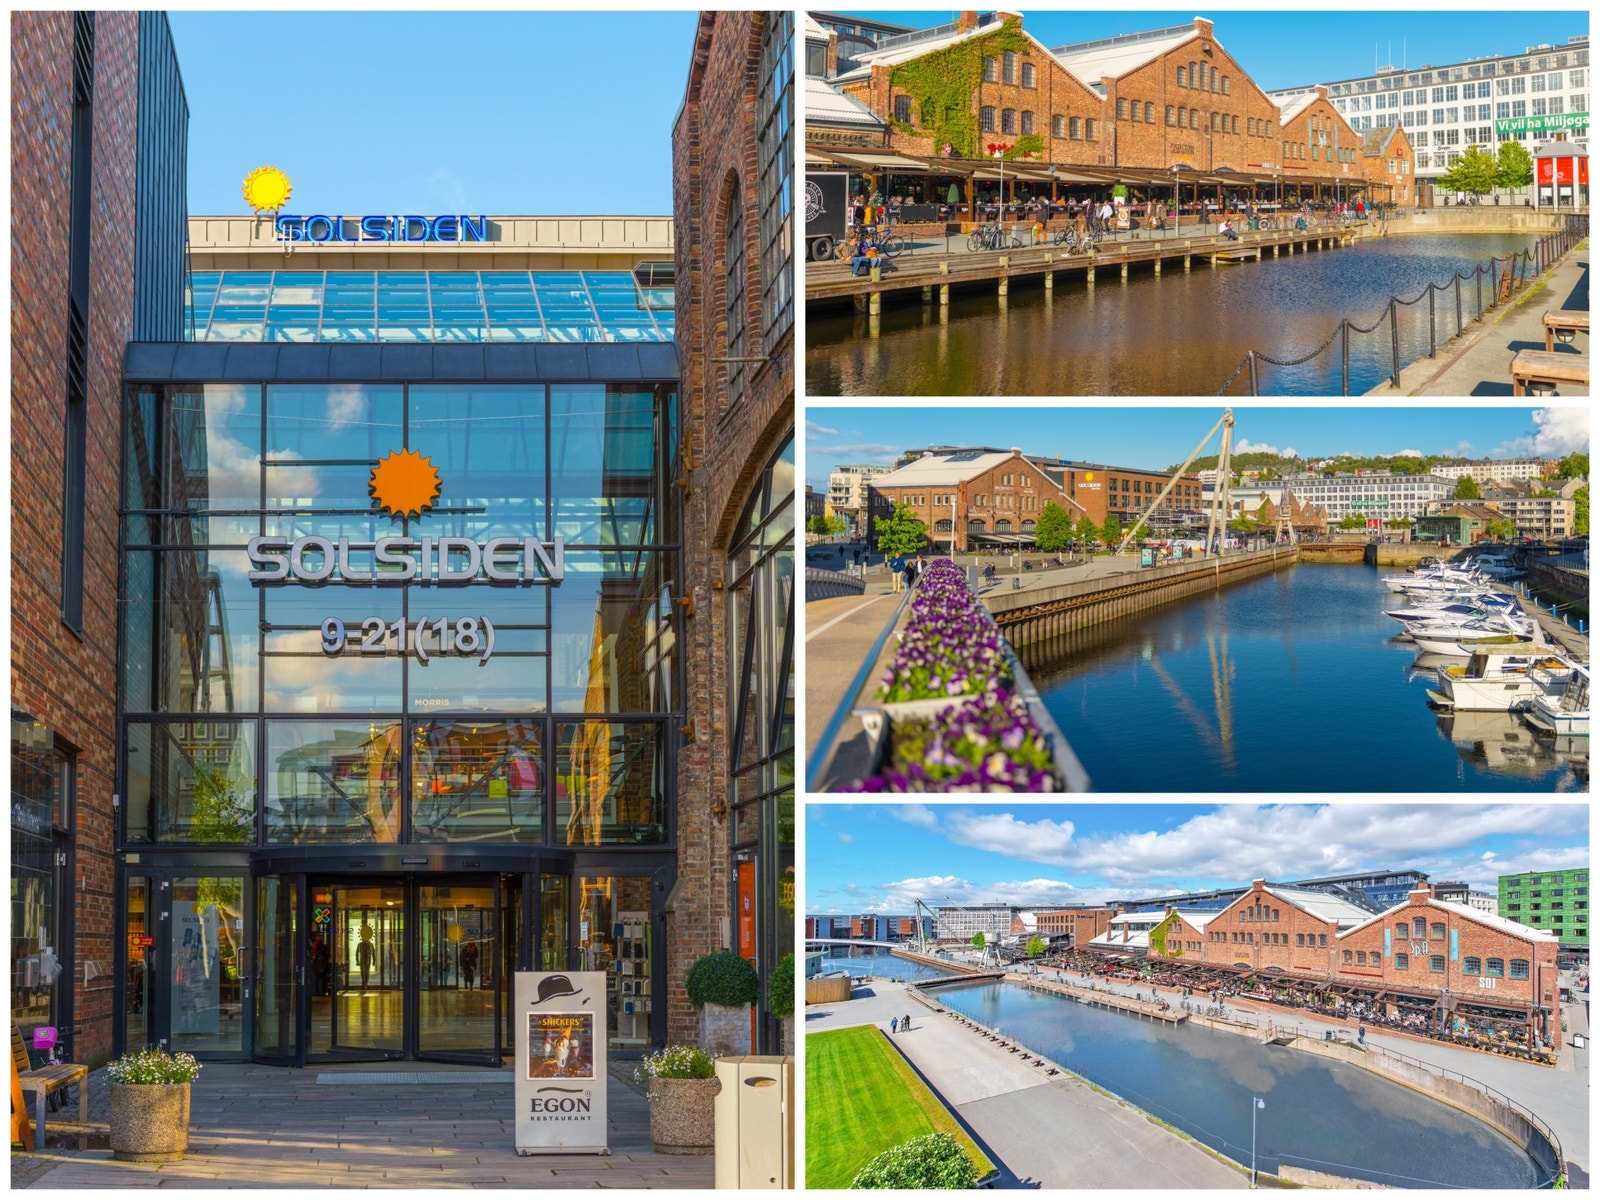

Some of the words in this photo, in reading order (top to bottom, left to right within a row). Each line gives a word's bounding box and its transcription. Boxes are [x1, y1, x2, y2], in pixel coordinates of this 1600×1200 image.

[1498, 120, 1509, 130] Vi
[1511, 118, 1525, 130] vil
[1527, 117, 1541, 128] ha
[275, 214, 488, 242] SOLSIDEN
[247, 535, 565, 583] SOLSIDEN
[320, 615, 496, 664] 9-21(18)
[414, 698, 450, 706] MORRIS
[530, 1097, 592, 1113] EGON
